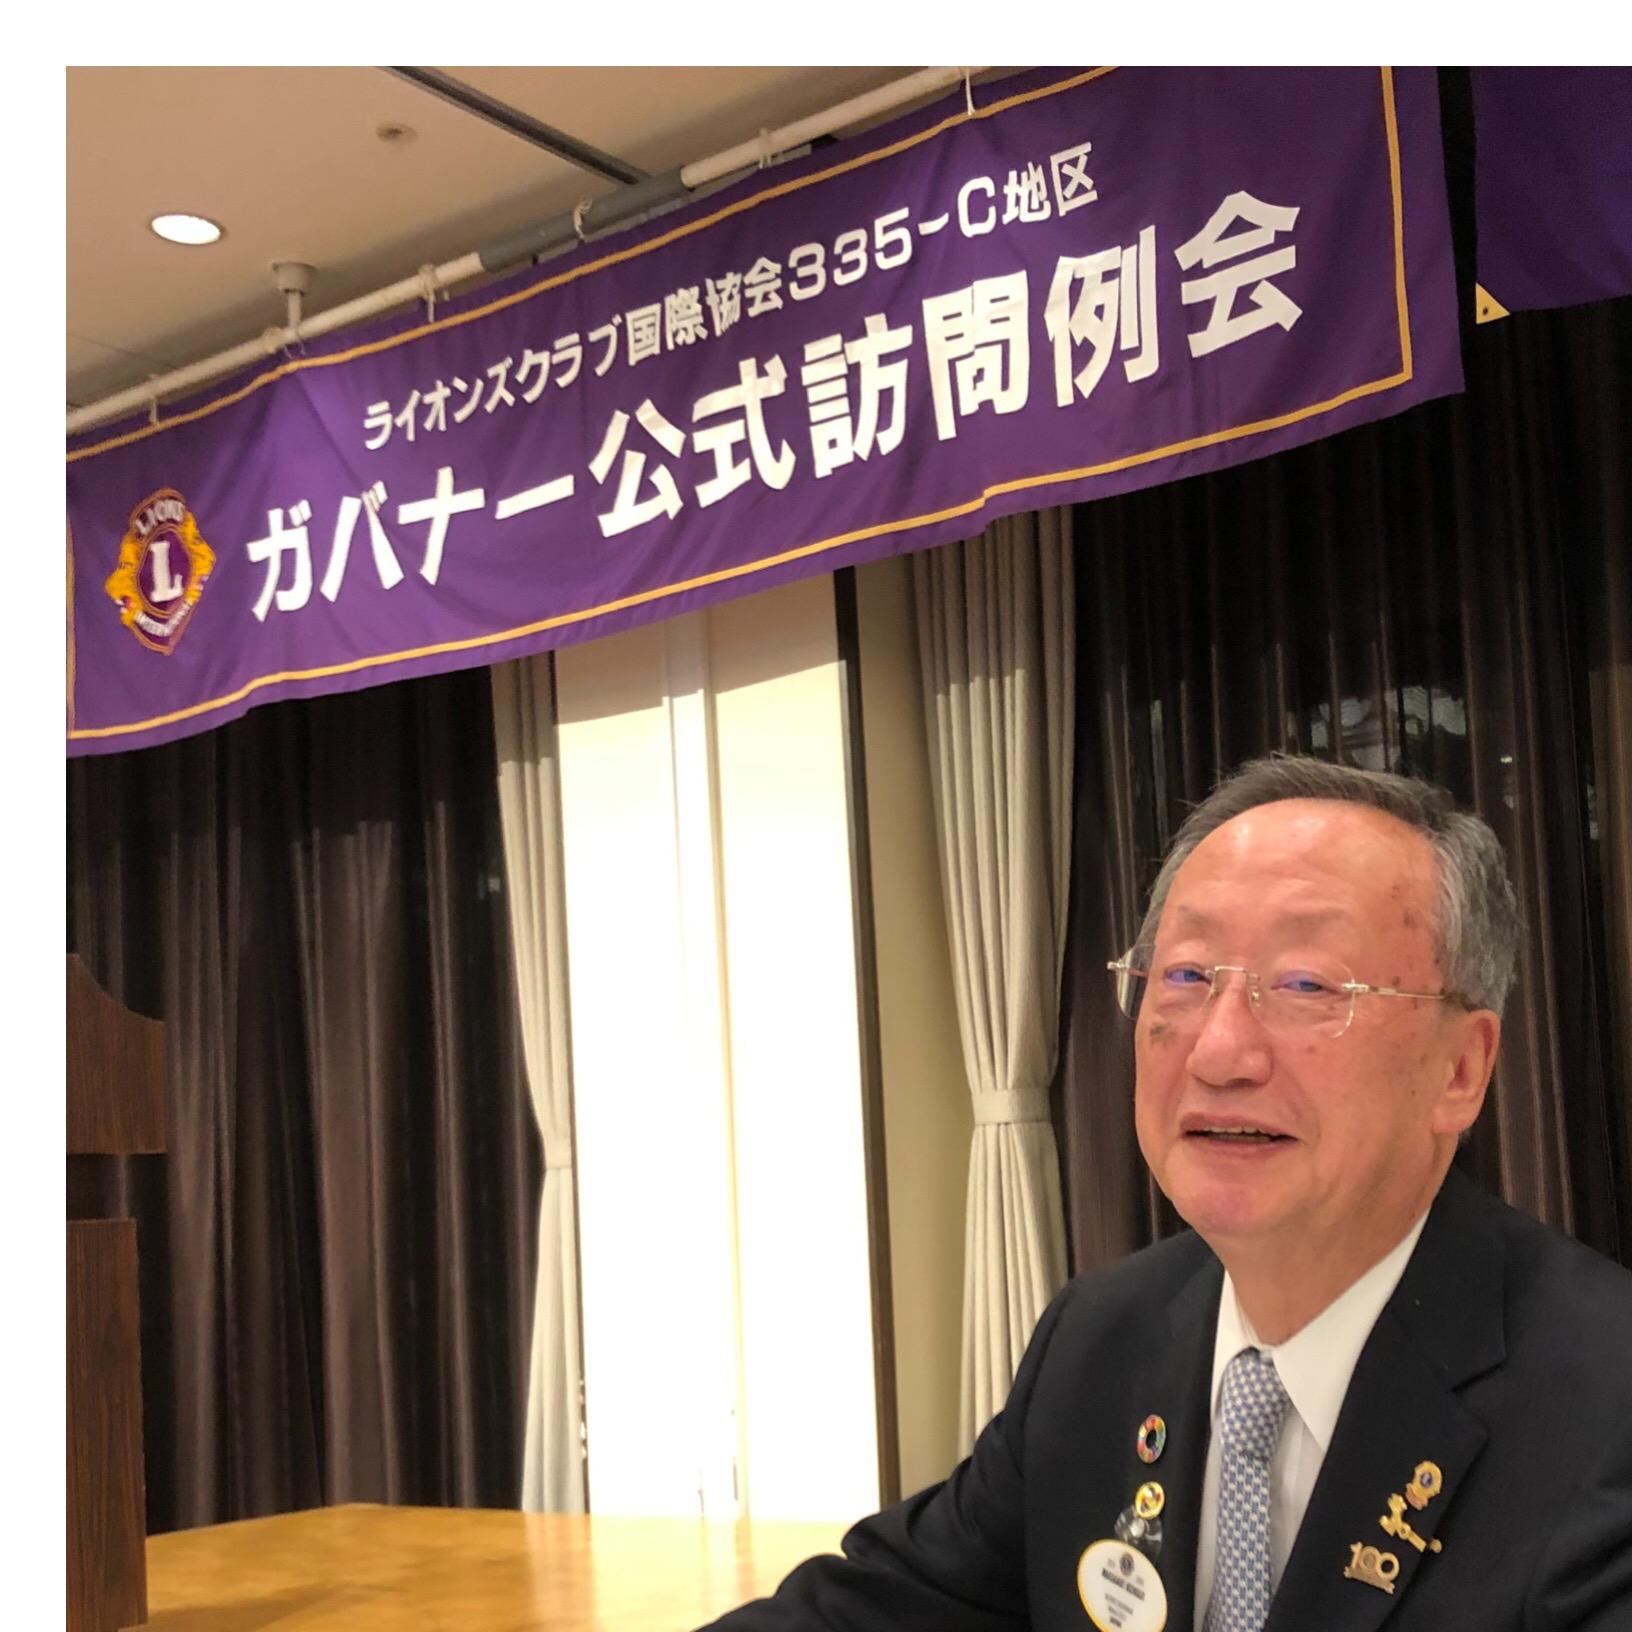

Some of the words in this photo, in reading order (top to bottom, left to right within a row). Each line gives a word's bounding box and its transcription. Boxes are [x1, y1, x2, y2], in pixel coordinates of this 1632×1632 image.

[246, 190, 1302, 621] ガバナー公式訪問例会
[150, 541, 183, 602] L
